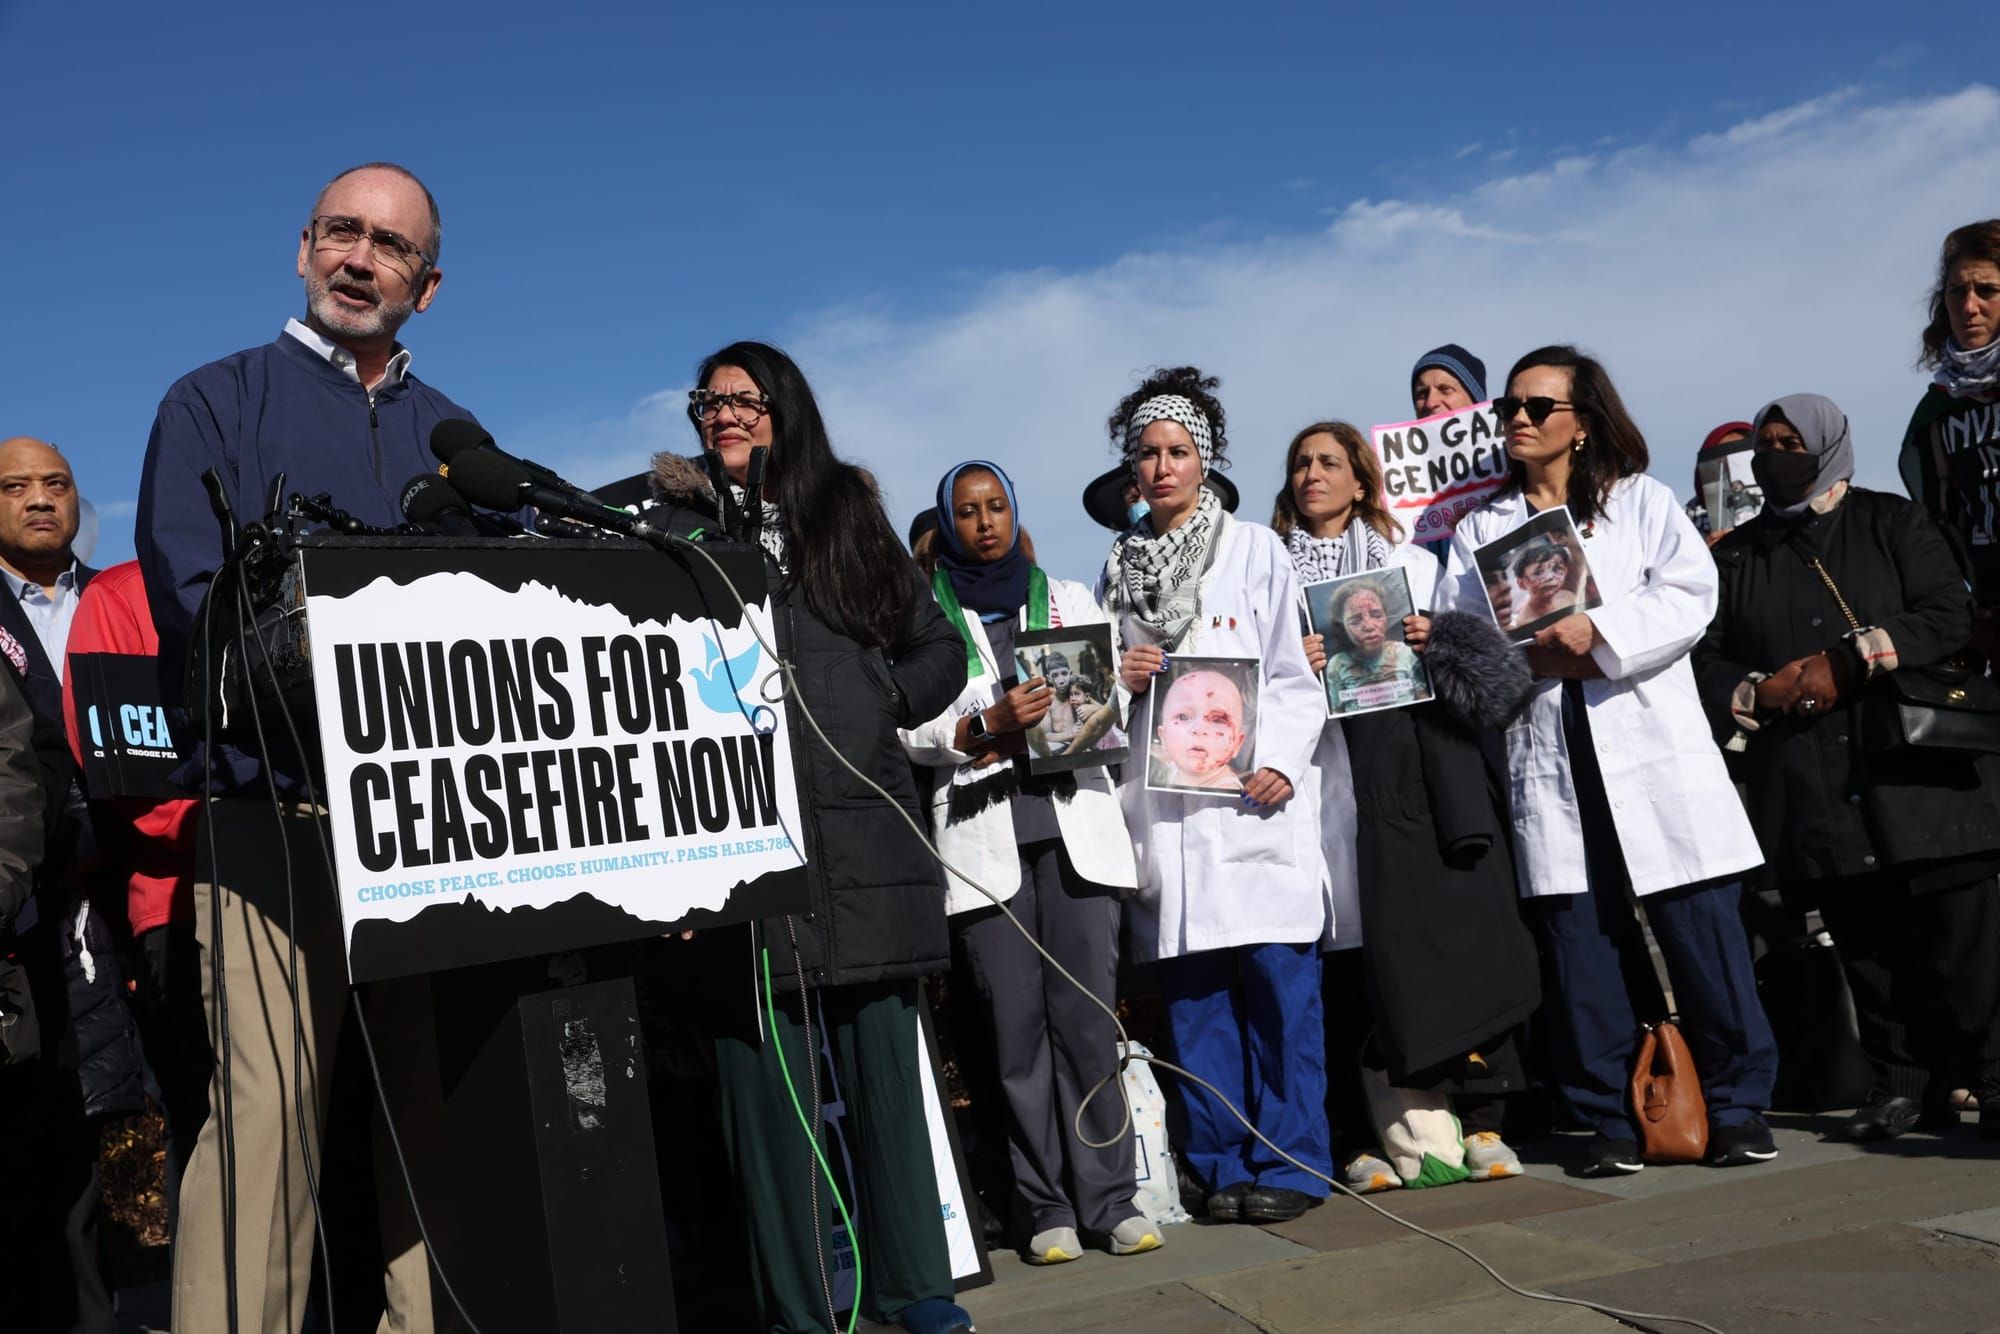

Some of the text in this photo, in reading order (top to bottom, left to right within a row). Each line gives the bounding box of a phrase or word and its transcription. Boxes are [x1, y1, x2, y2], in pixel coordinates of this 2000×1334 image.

[1382, 427, 1429, 463] NO
[1384, 442, 1508, 496] GENOCI
[333, 634, 689, 754] UNIONS FOR
[126, 748, 161, 758] CHOOSE
[349, 733, 779, 873] CEASEFIRE NOW
[358, 836, 792, 903] CHOOSE PEACE. CHOOSE HUMANITY. PASS H.RES.786
